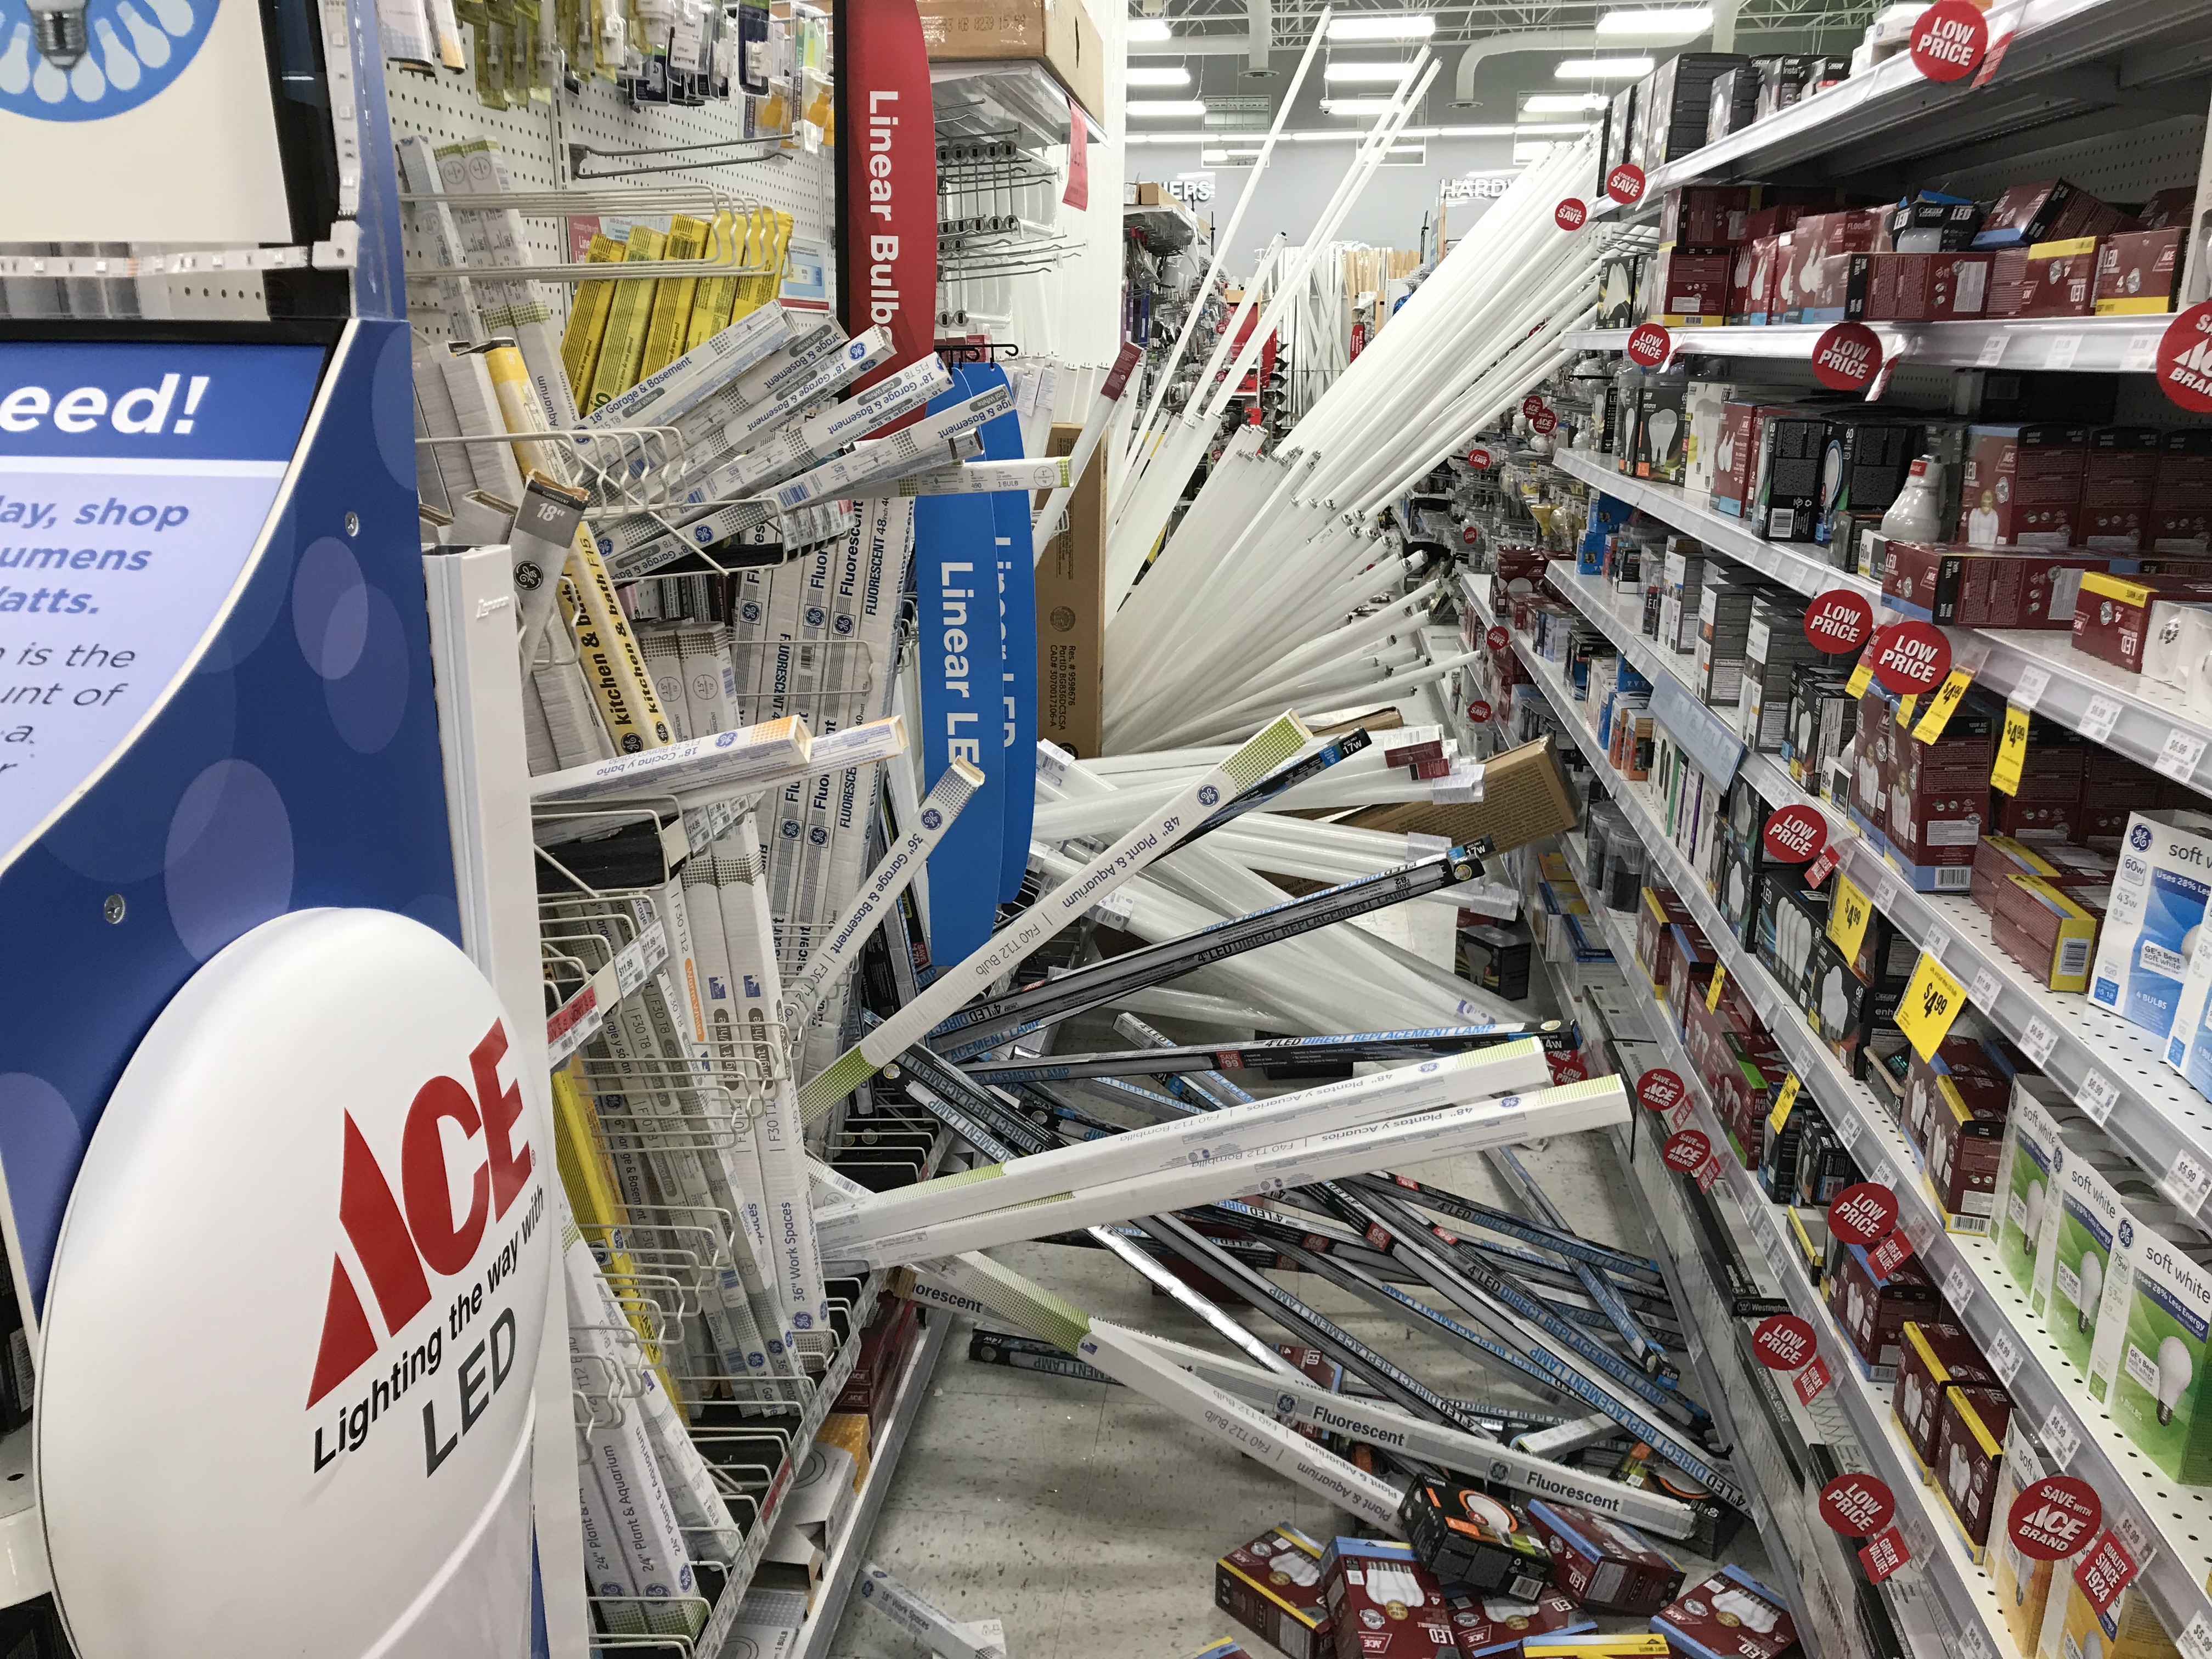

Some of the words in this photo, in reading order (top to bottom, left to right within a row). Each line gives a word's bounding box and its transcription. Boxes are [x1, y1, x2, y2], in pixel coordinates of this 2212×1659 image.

[1931, 16, 1975, 44] LOW
[1916, 35, 1975, 67] PRICE
[870, 91, 899, 221] Linear
[1440, 178, 1513, 198] HARD
[1611, 176, 1640, 197] SAVE
[1618, 172, 1631, 180] STOCK
[1558, 208, 1582, 224] SAVE
[1632, 339, 1662, 359] PRICE
[1639, 330, 1663, 348] LOW
[1831, 336, 1871, 359] LOW
[764, 356, 809, 390] Basement
[1818, 351, 1869, 380] PRICE
[606, 390, 640, 414] Garage
[647, 356, 692, 391] Basement
[882, 381, 918, 404] Garage
[747, 400, 790, 432] Basement
[827, 405, 876, 435] Basement
[938, 414, 986, 439] Basement
[1472, 456, 1487, 465] SAVE
[74, 498, 189, 532] shop
[537, 504, 566, 522] 18"
[896, 498, 914, 594] Fluorescent
[866, 535, 885, 616] FLUORESCENT
[876, 518, 887, 535] 48
[596, 574, 619, 616] bath
[1822, 602, 1862, 625] LOW
[941, 562, 974, 698] Linear
[1488, 634, 1505, 646] SAVE
[1810, 615, 1860, 642] PRICE
[16, 642, 54, 665] is
[65, 644, 136, 668] the
[1049, 645, 1058, 668] CAD#
[1068, 645, 1076, 663] Res.
[1894, 635, 1938, 663] LOW
[628, 643, 659, 713] kitchen
[1879, 650, 1936, 684] PRICE
[73, 683, 128, 706] of
[600, 653, 633, 725] kitchen
[1470, 707, 1487, 718] SAVE
[947, 713, 979, 764] LE
[1342, 740, 1363, 755] 17W
[596, 761, 627, 777] baño
[639, 752, 676, 766] Cocina
[1768, 823, 1813, 857] PRICE
[1782, 815, 1817, 839] LOW
[907, 833, 923, 855] 36"
[1130, 836, 1158, 861] Plant
[1465, 845, 1486, 858] 17W
[2169, 844, 2203, 866] soft
[878, 853, 909, 894] Garage
[2177, 877, 2196, 891] 28%
[1062, 865, 1116, 910] Aquarium
[830, 901, 872, 955] Basement
[917, 943, 927, 963] SAVE
[975, 953, 1001, 976] Bulb
[2145, 945, 2162, 956] GE's
[2163, 950, 2181, 963] Best
[1302, 1034, 1352, 1046] DIRECT
[1351, 1026, 1453, 1043] REPLACEMENT
[1453, 1023, 1497, 1036] LAMP
[1220, 1053, 1239, 1061] SAVE
[1316, 1079, 1363, 1095] Plantas
[1651, 1073, 1670, 1085] SAVE
[1246, 1094, 1302, 1111] Acuarios
[1643, 1093, 1670, 1108] BRAND
[1644, 1082, 1678, 1103] ACE
[1393, 1112, 1443, 1129] Plantas
[2023, 1107, 2039, 1128] soft
[1321, 1125, 1378, 1143] Acuarios
[1678, 1133, 1697, 1147] SAVE
[1192, 1150, 1244, 1169] Bombilla
[1667, 1153, 1694, 1168] BRAND
[1669, 1142, 1703, 1164] ACE
[1852, 1192, 1888, 1221] LOW
[2072, 1171, 2092, 1195] soft
[2092, 1187, 2117, 1219] white
[306, 1017, 533, 1410] ACE
[781, 1201, 798, 1244] Spaces
[1835, 1201, 1880, 1238] PRICE
[786, 1247, 802, 1280] Work
[1875, 1249, 1894, 1273] VALUE!
[1885, 1239, 1903, 1262] GREAT
[2146, 1246, 2172, 1274] soft
[2173, 1267, 2211, 1304] white
[791, 1283, 805, 1302] 36"
[314, 1327, 442, 1474] Lighting
[449, 1283, 482, 1340] the
[487, 1228, 518, 1294] way
[521, 1184, 544, 1242] with
[1476, 1271, 1501, 1293] LED
[1500, 1286, 1543, 1326] DIRECT
[1543, 1314, 1631, 1375] REPLACEMENT
[1626, 1367, 1668, 1407] LAMP
[1773, 1323, 1806, 1348] LOW
[1758, 1332, 1802, 1364] PRICE
[1530, 1348, 1565, 1376] LAMP
[1807, 1365, 1824, 1390] GREAT
[421, 1307, 516, 1479] LED
[1313, 1405, 1406, 1447] Fluorescent
[1658, 1438, 1707, 1480] DIRECT
[604, 1444, 629, 1504] Aquarium
[1297, 1461, 1352, 1499] Aquarium
[1526, 1471, 1620, 1512] Fluorescent
[1845, 1482, 1884, 1514] LOW
[2041, 1485, 2074, 1511] SAVE
[2074, 1501, 2092, 1519] WITH
[1362, 1502, 1393, 1523] Plant
[1826, 1489, 1874, 1533] PRICE
[2022, 1503, 2088, 1541] ACE
[629, 1518, 646, 1551] Plant
[2018, 1525, 2070, 1553] BRAND
[1879, 1537, 1899, 1568] GREAT
[2103, 1542, 2128, 1573] QUALITY
[2084, 1566, 2111, 1604] 1924
[2095, 1554, 2125, 1591] SINCE
